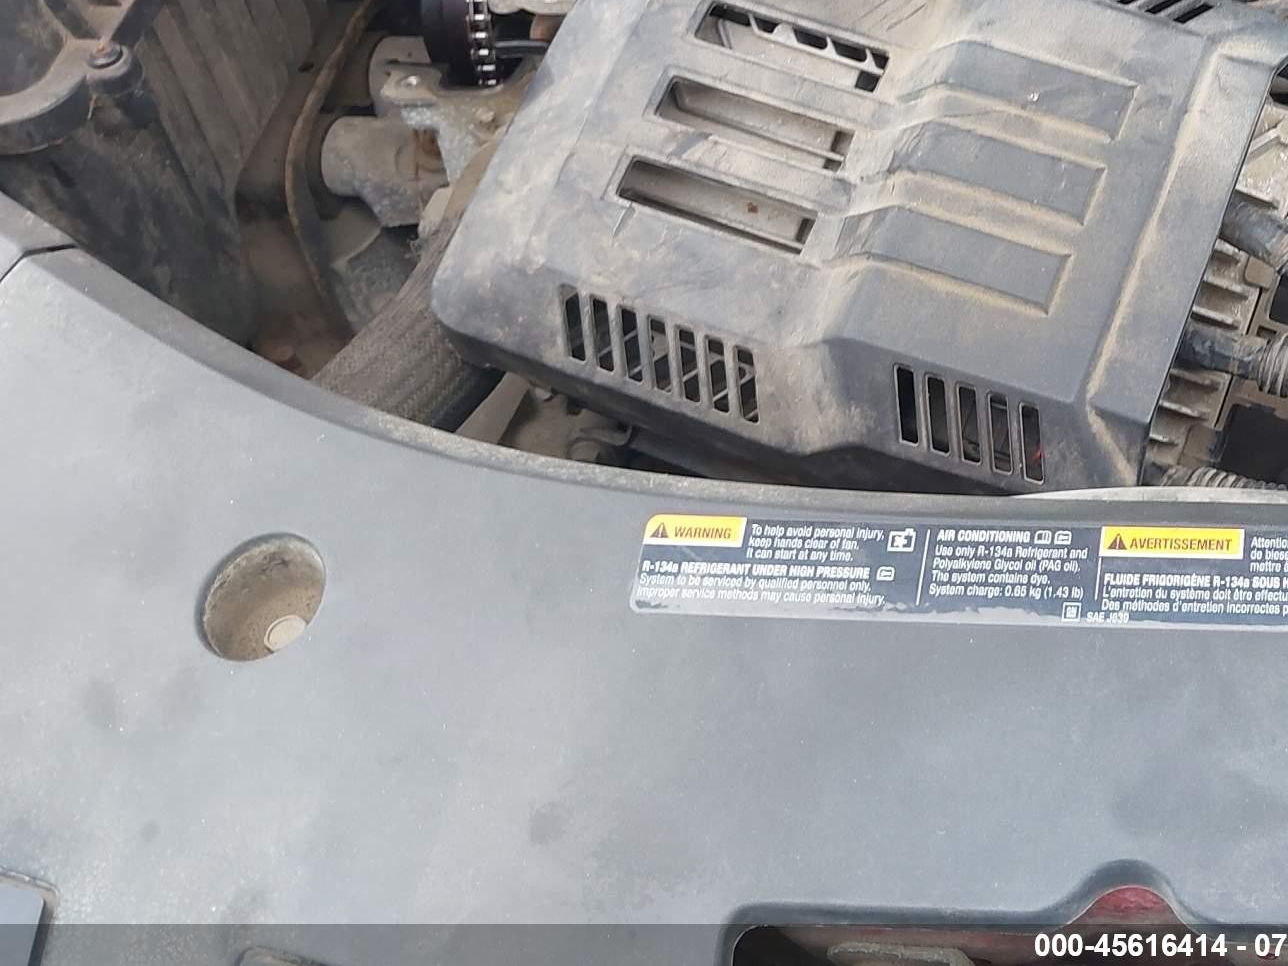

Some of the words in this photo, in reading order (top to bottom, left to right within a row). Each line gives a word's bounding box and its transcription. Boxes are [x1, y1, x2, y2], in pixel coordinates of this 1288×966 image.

[674, 525, 731, 539] WARNING
[752, 524, 762, 535] To
[764, 525, 784, 537] help
[787, 526, 811, 538] avoid
[815, 527, 854, 541] personal
[937, 530, 955, 542] AIR
[958, 531, 1030, 542] CONDITIONING
[749, 536, 771, 550] keep
[775, 537, 802, 549] hands
[805, 538, 828, 549] clear
[831, 539, 840, 550] of
[843, 538, 859, 550] fan.
[1130, 538, 1232, 551] AVERTISSEMENT
[747, 548, 753, 558] It
[755, 550, 772, 559] can
[775, 549, 796, 559] start
[799, 550, 807, 560] at
[810, 551, 827, 562] any
[830, 550, 854, 561] time.
[936, 546, 952, 556] Use
[956, 546, 974, 557] only
[978, 547, 1012, 557] R-134a
[1015, 547, 1068, 559] Refrigerant
[1070, 548, 1088, 559] and
[1251, 550, 1260, 560] de
[643, 561, 678, 573] R-134a
[682, 562, 749, 576] REFRIGERANT
[752, 565, 787, 576] UNDER
[790, 566, 815, 577] HIGH
[817, 567, 870, 579] PRESSURE
[933, 558, 991, 571] Polyalkylene
[994, 559, 1022, 572] Glycol
[1025, 560, 1035, 570] oil
[1039, 560, 1060, 573] (PAG
[1063, 560, 1080, 572] oil).
[1250, 562, 1281, 573] mettre
[640, 574, 675, 587] System
[678, 576, 685, 585] to
[689, 576, 702, 586] be
[705, 576, 743, 588] serviced
[745, 578, 756, 590] by
[759, 578, 798, 591] qualified
[801, 579, 847, 592] personnel
[850, 581, 871, 594] only.
[932, 571, 948, 582] The
[952, 572, 985, 585] system
[988, 573, 1028, 584] contains
[1030, 574, 1050, 586] dye.
[1104, 574, 1139, 585] FLUIDE
[1143, 573, 1209, 587] FRIGORIGÈNE
[1213, 576, 1249, 588] R-134a
[1252, 577, 1280, 588] SOUS
[637, 586, 679, 600] Improper
[682, 588, 715, 599] service
[718, 589, 758, 600] methods
[761, 591, 781, 603] may
[784, 592, 812, 602] cause
[815, 592, 854, 605] personal
[929, 584, 964, 596] System
[967, 585, 1002, 598] charge:
[1005, 585, 1027, 596] 0.65
[1030, 585, 1041, 599] kg
[1044, 586, 1068, 599] (1.43
[1071, 586, 1083, 599] lb)
[1156, 588, 1167, 599] du
[1170, 588, 1210, 601] système
[1213, 588, 1230, 600] doit
[1233, 589, 1252, 601] être
[1102, 599, 1120, 610] Des
[1123, 599, 1170, 611] méthodes
[1227, 602, 1280, 614] incorrectes
[1087, 612, 1104, 621] SAE
